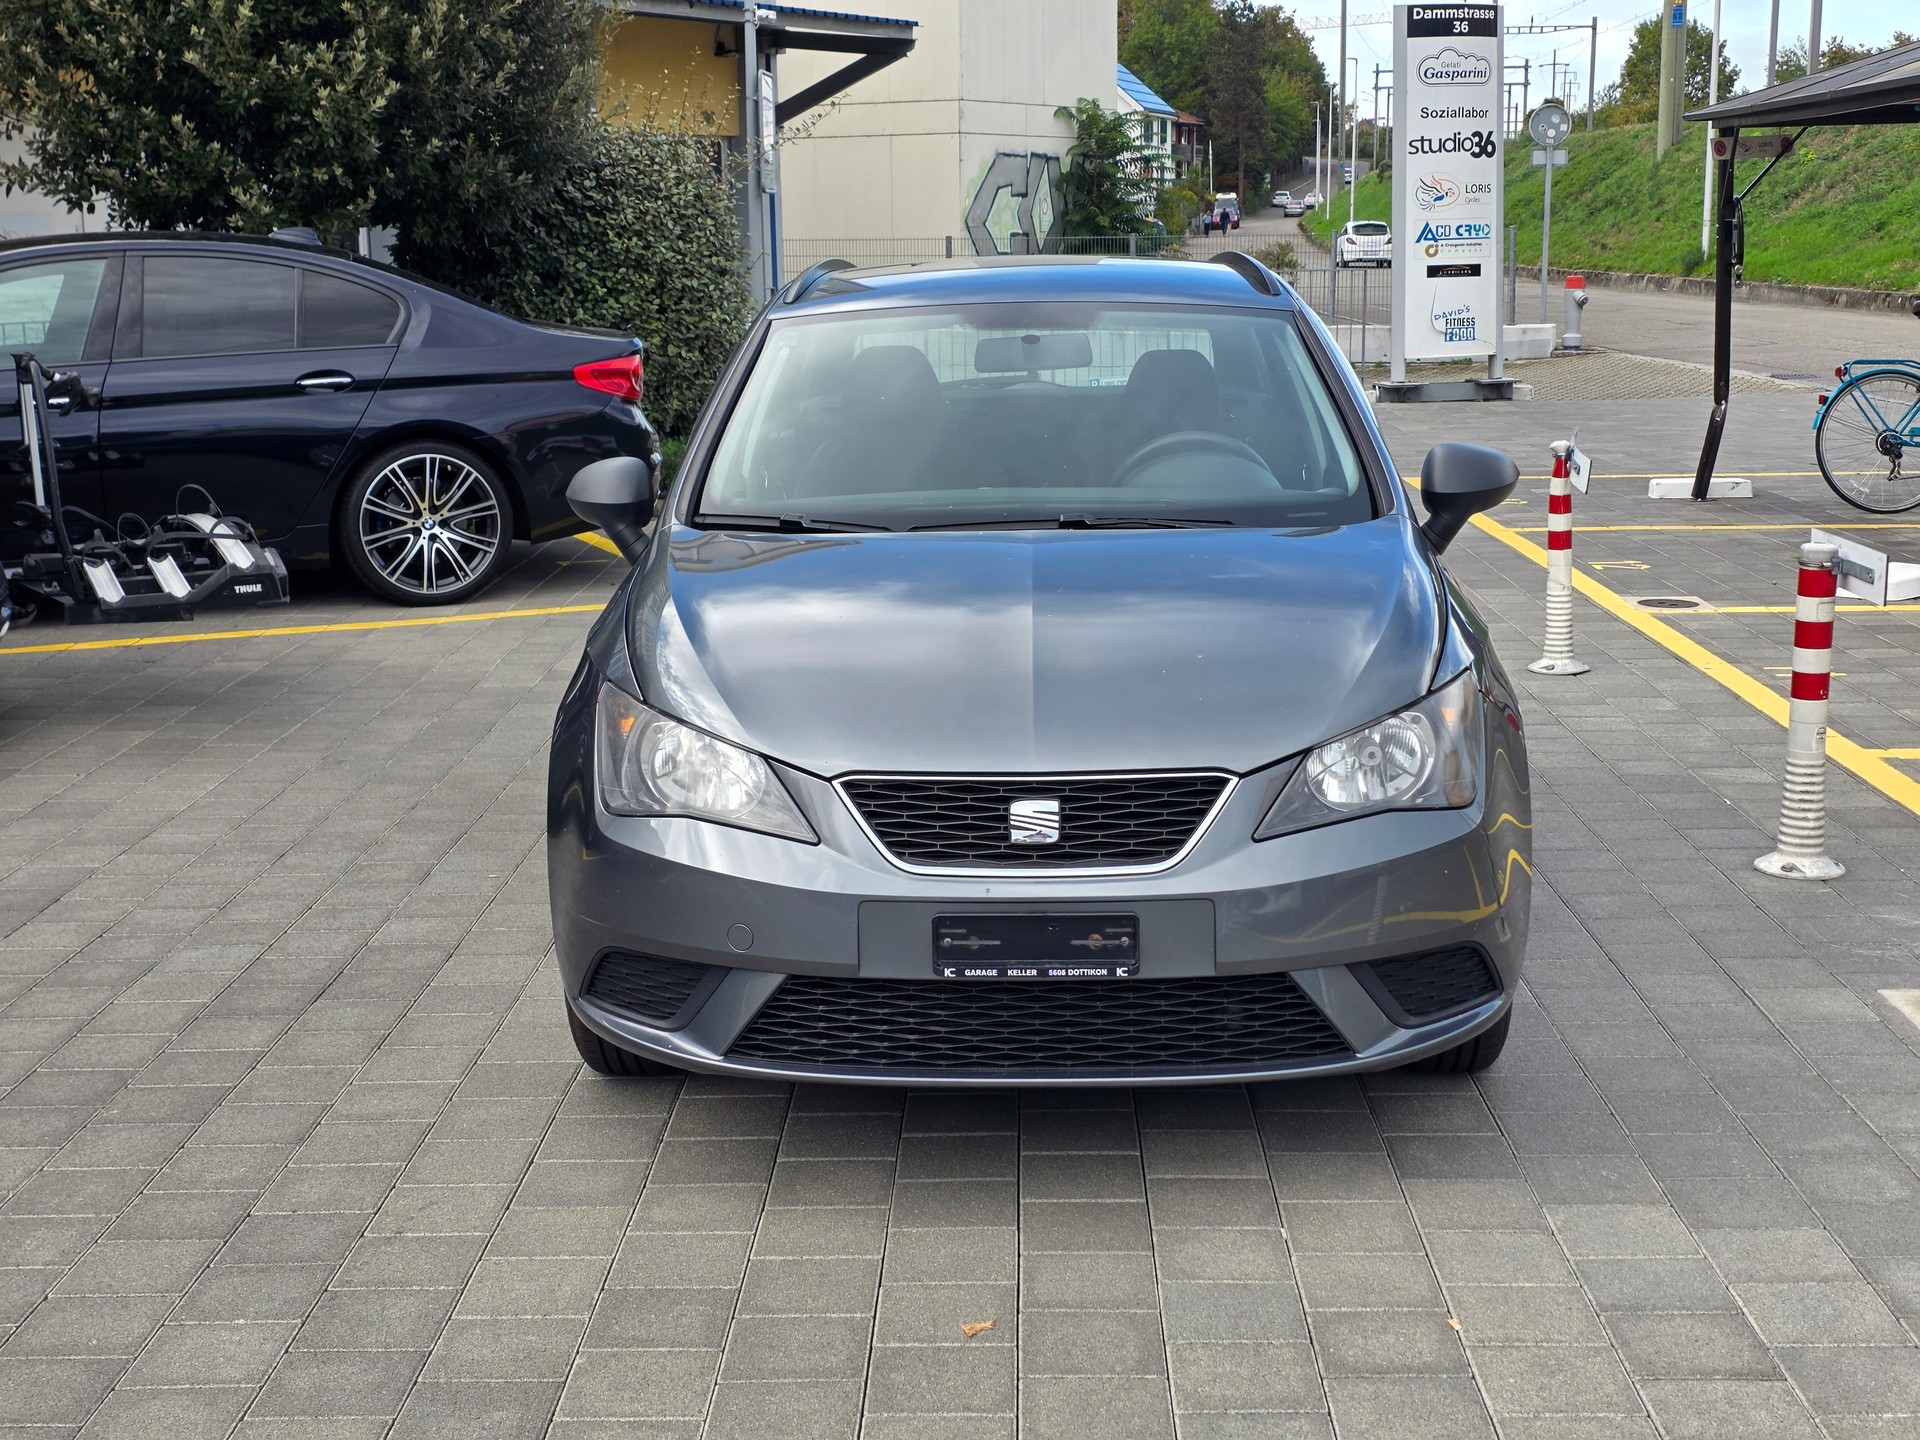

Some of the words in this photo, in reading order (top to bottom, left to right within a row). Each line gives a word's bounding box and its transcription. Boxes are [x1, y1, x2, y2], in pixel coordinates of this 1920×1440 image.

[1413, 7, 1495, 20] Dammstrasse
[1453, 21, 1469, 33] 36
[1441, 61, 1462, 69] Gelati
[1423, 66, 1488, 81] Gasparini
[1420, 106, 1489, 119] Soziallabor
[1408, 130, 1497, 159] studio36
[1465, 183, 1492, 194] LORIS
[1455, 223, 1491, 237] CRYO
[1445, 317, 1476, 327] FITNESS
[1446, 328, 1475, 342] FOOD
[234, 584, 262, 594] THULE
[1068, 968, 1108, 976] DOTTIKON
